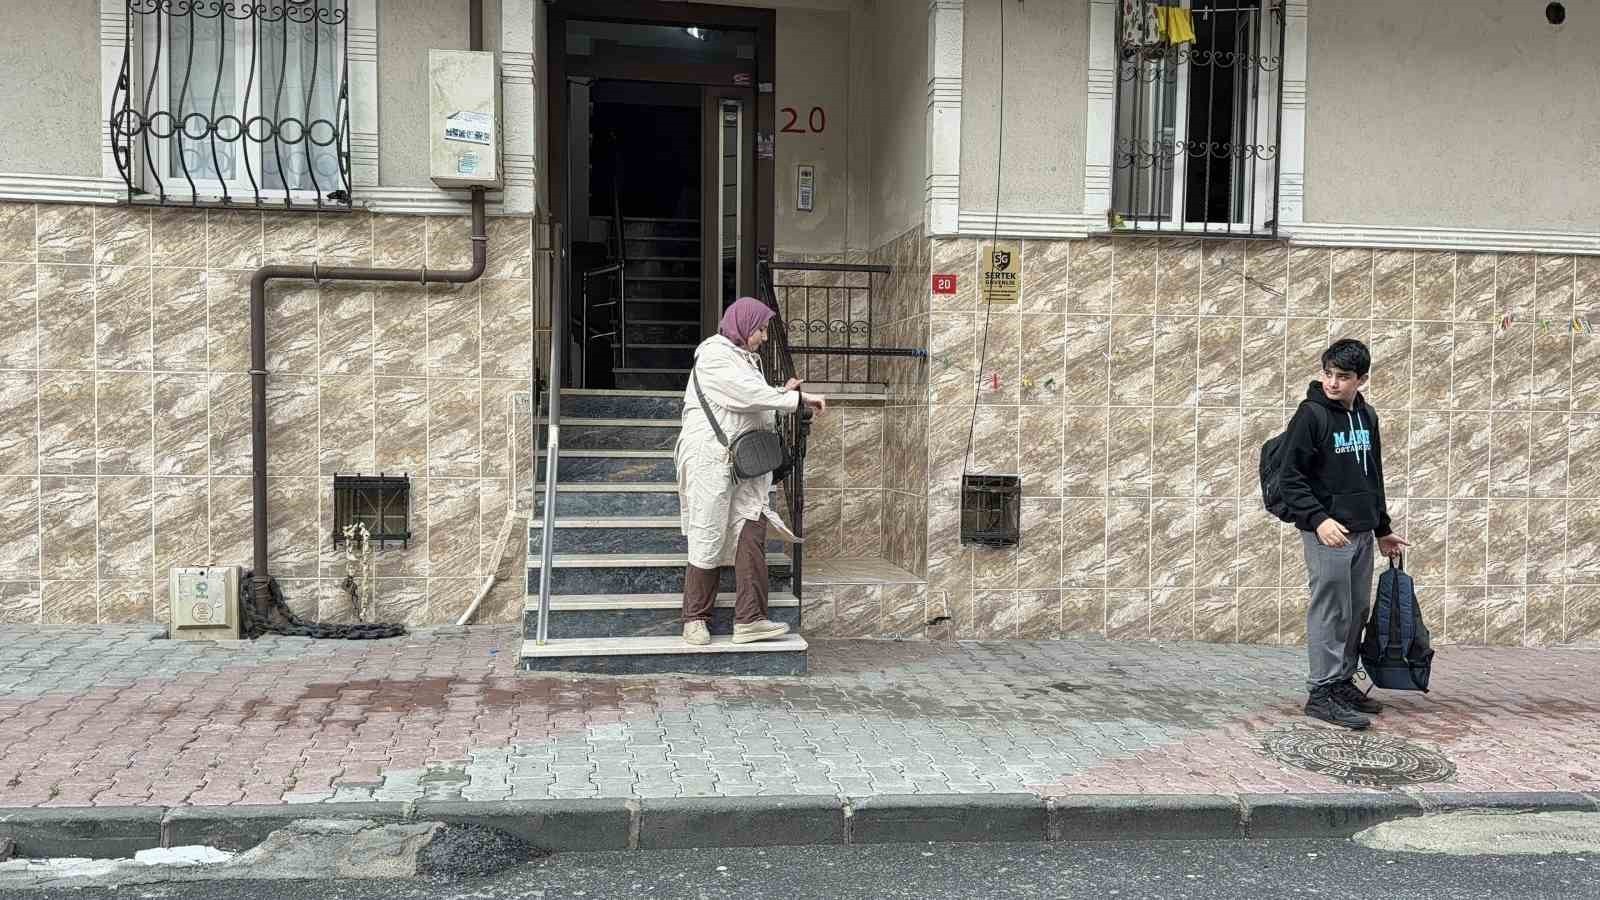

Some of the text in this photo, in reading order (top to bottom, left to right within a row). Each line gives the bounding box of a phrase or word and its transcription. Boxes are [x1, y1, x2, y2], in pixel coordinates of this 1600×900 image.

[780, 106, 826, 134] 20
[985, 271, 1016, 280] SERTEK
[938, 279, 951, 289] 20
